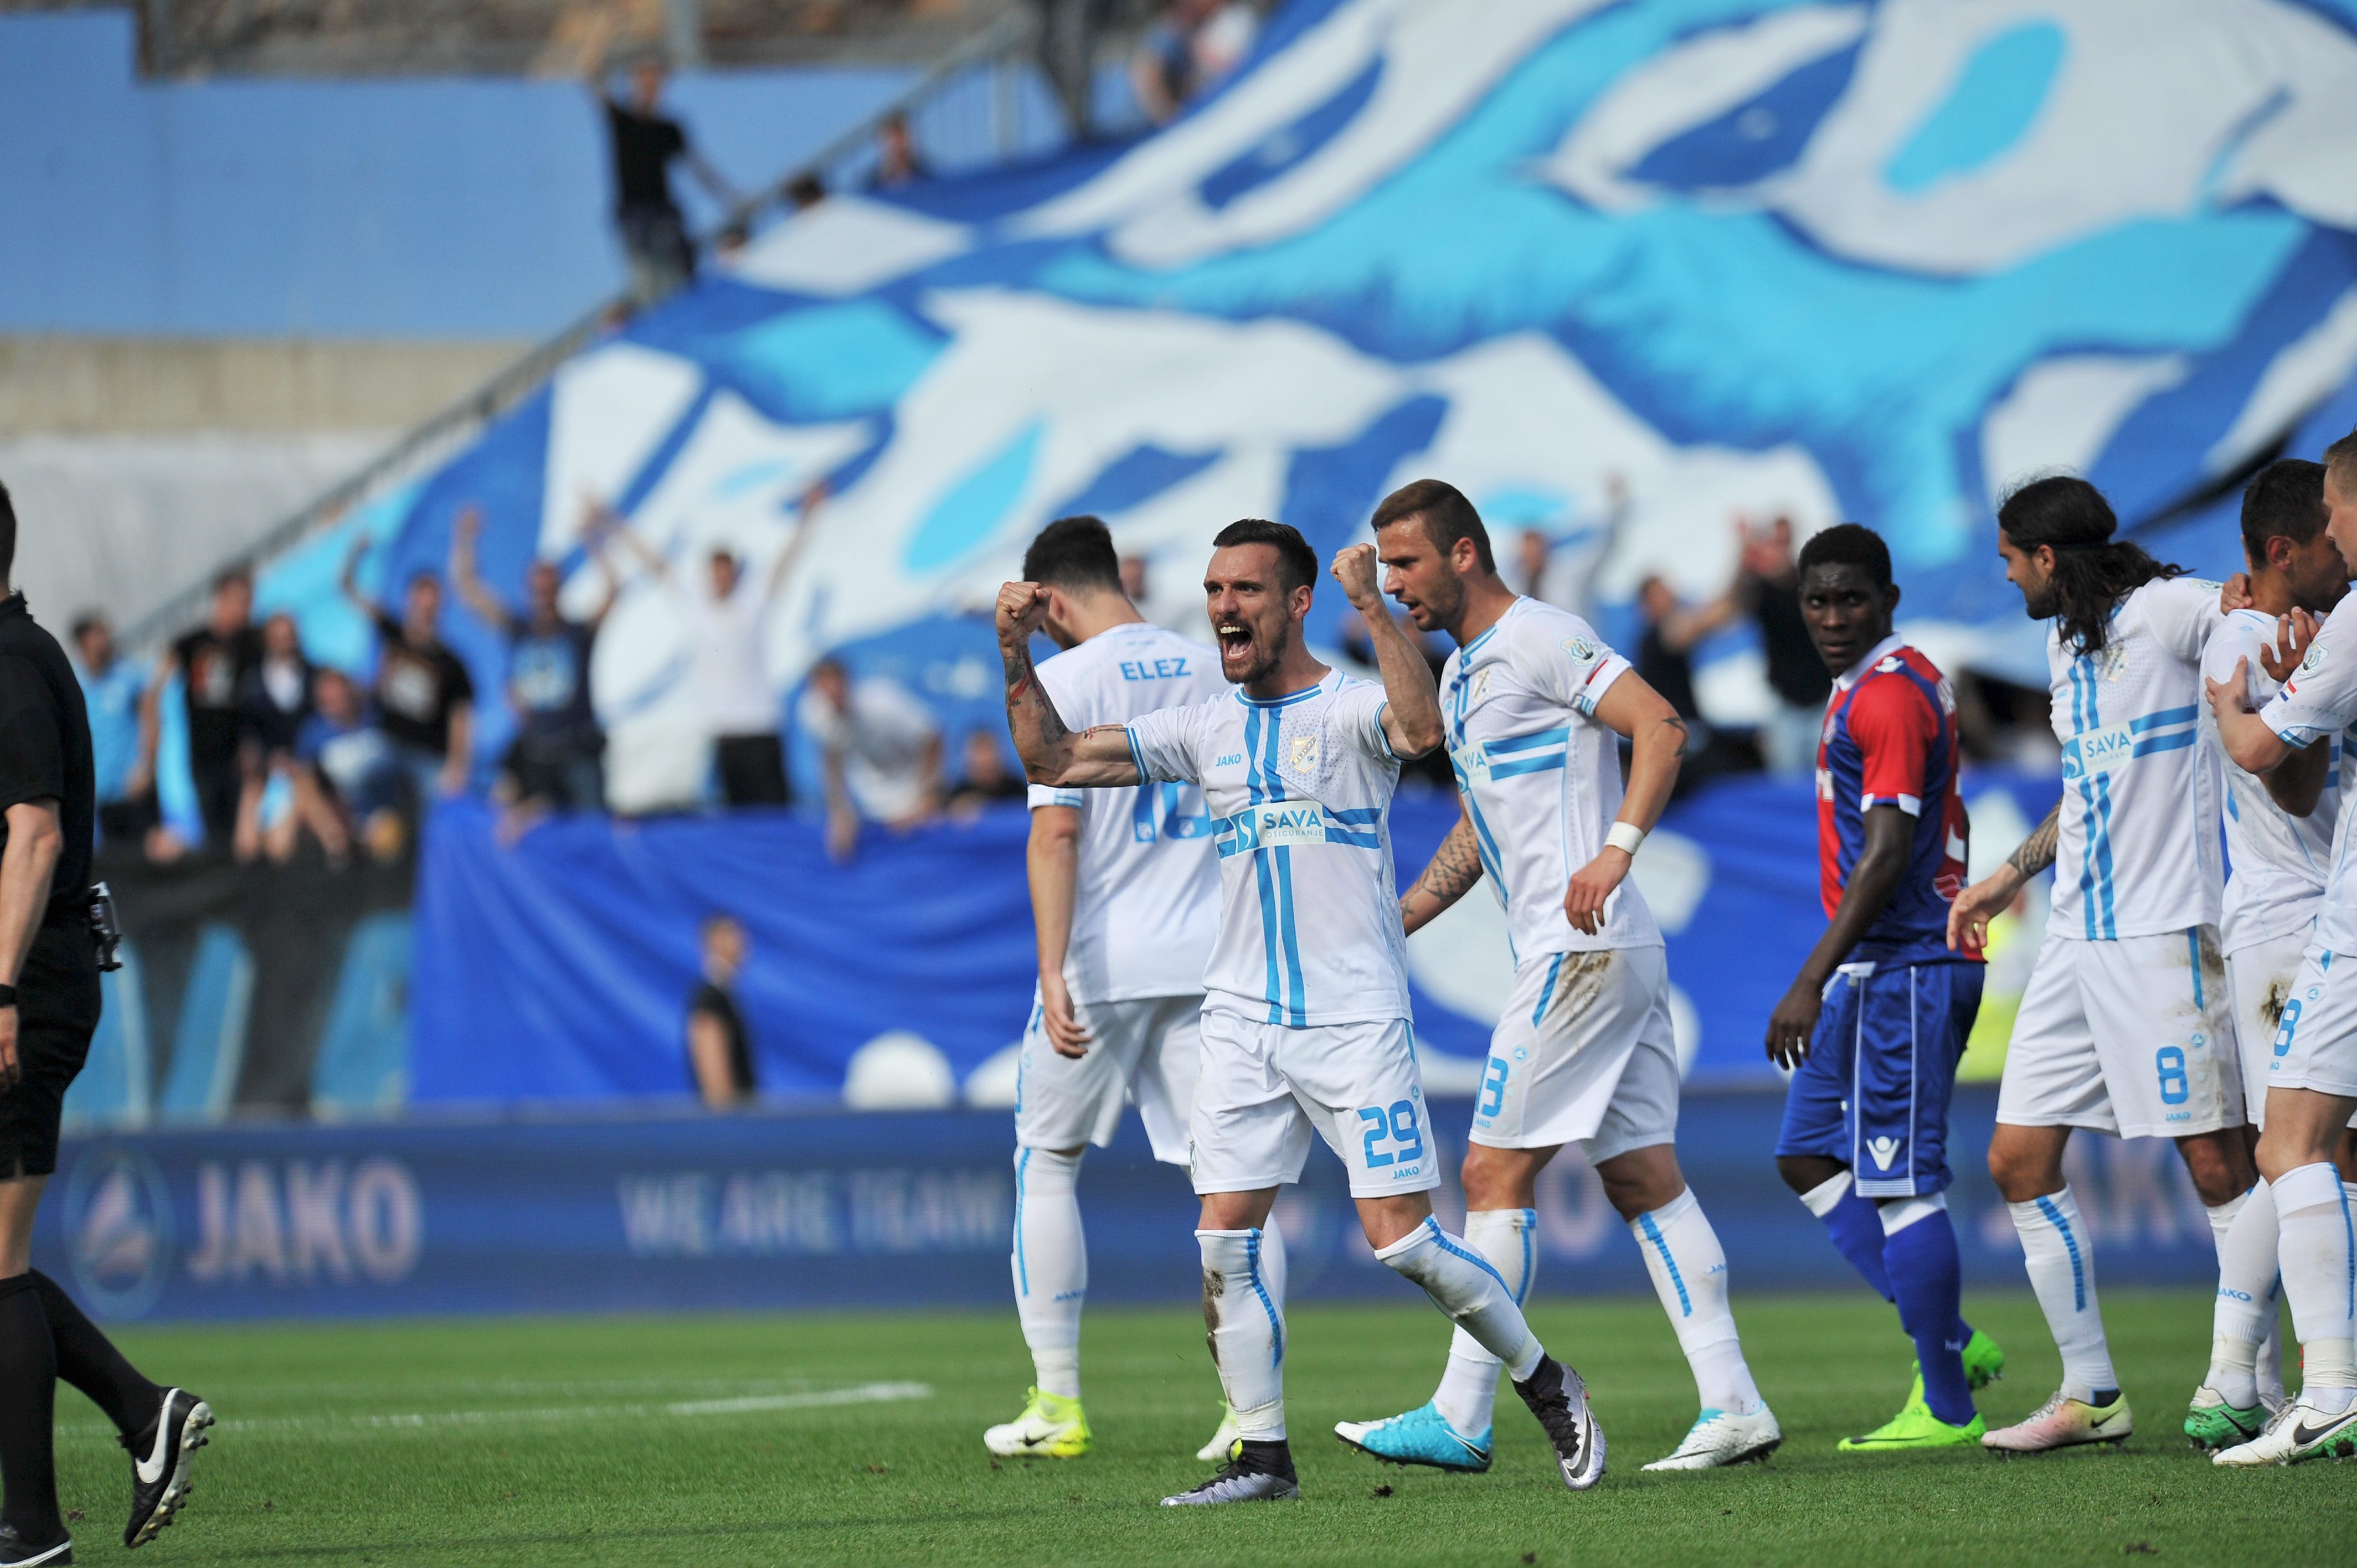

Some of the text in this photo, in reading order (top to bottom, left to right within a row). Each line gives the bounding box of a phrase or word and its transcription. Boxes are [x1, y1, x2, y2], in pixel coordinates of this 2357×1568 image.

[1119, 658, 1191, 680] ELEZ
[2086, 731, 2131, 757] SAVA
[1216, 753, 1242, 767] JAKO
[1263, 809, 1322, 829] SAVA
[1267, 830, 1324, 838] OSIGURANJE
[2274, 998, 2302, 1056] 8
[2157, 1046, 2189, 1105] 8
[2166, 1111, 2191, 1121] JAKO
[1357, 1100, 1423, 1168] 29
[1393, 1166, 1419, 1179] JAKO
[187, 1157, 424, 1285] JAKO
